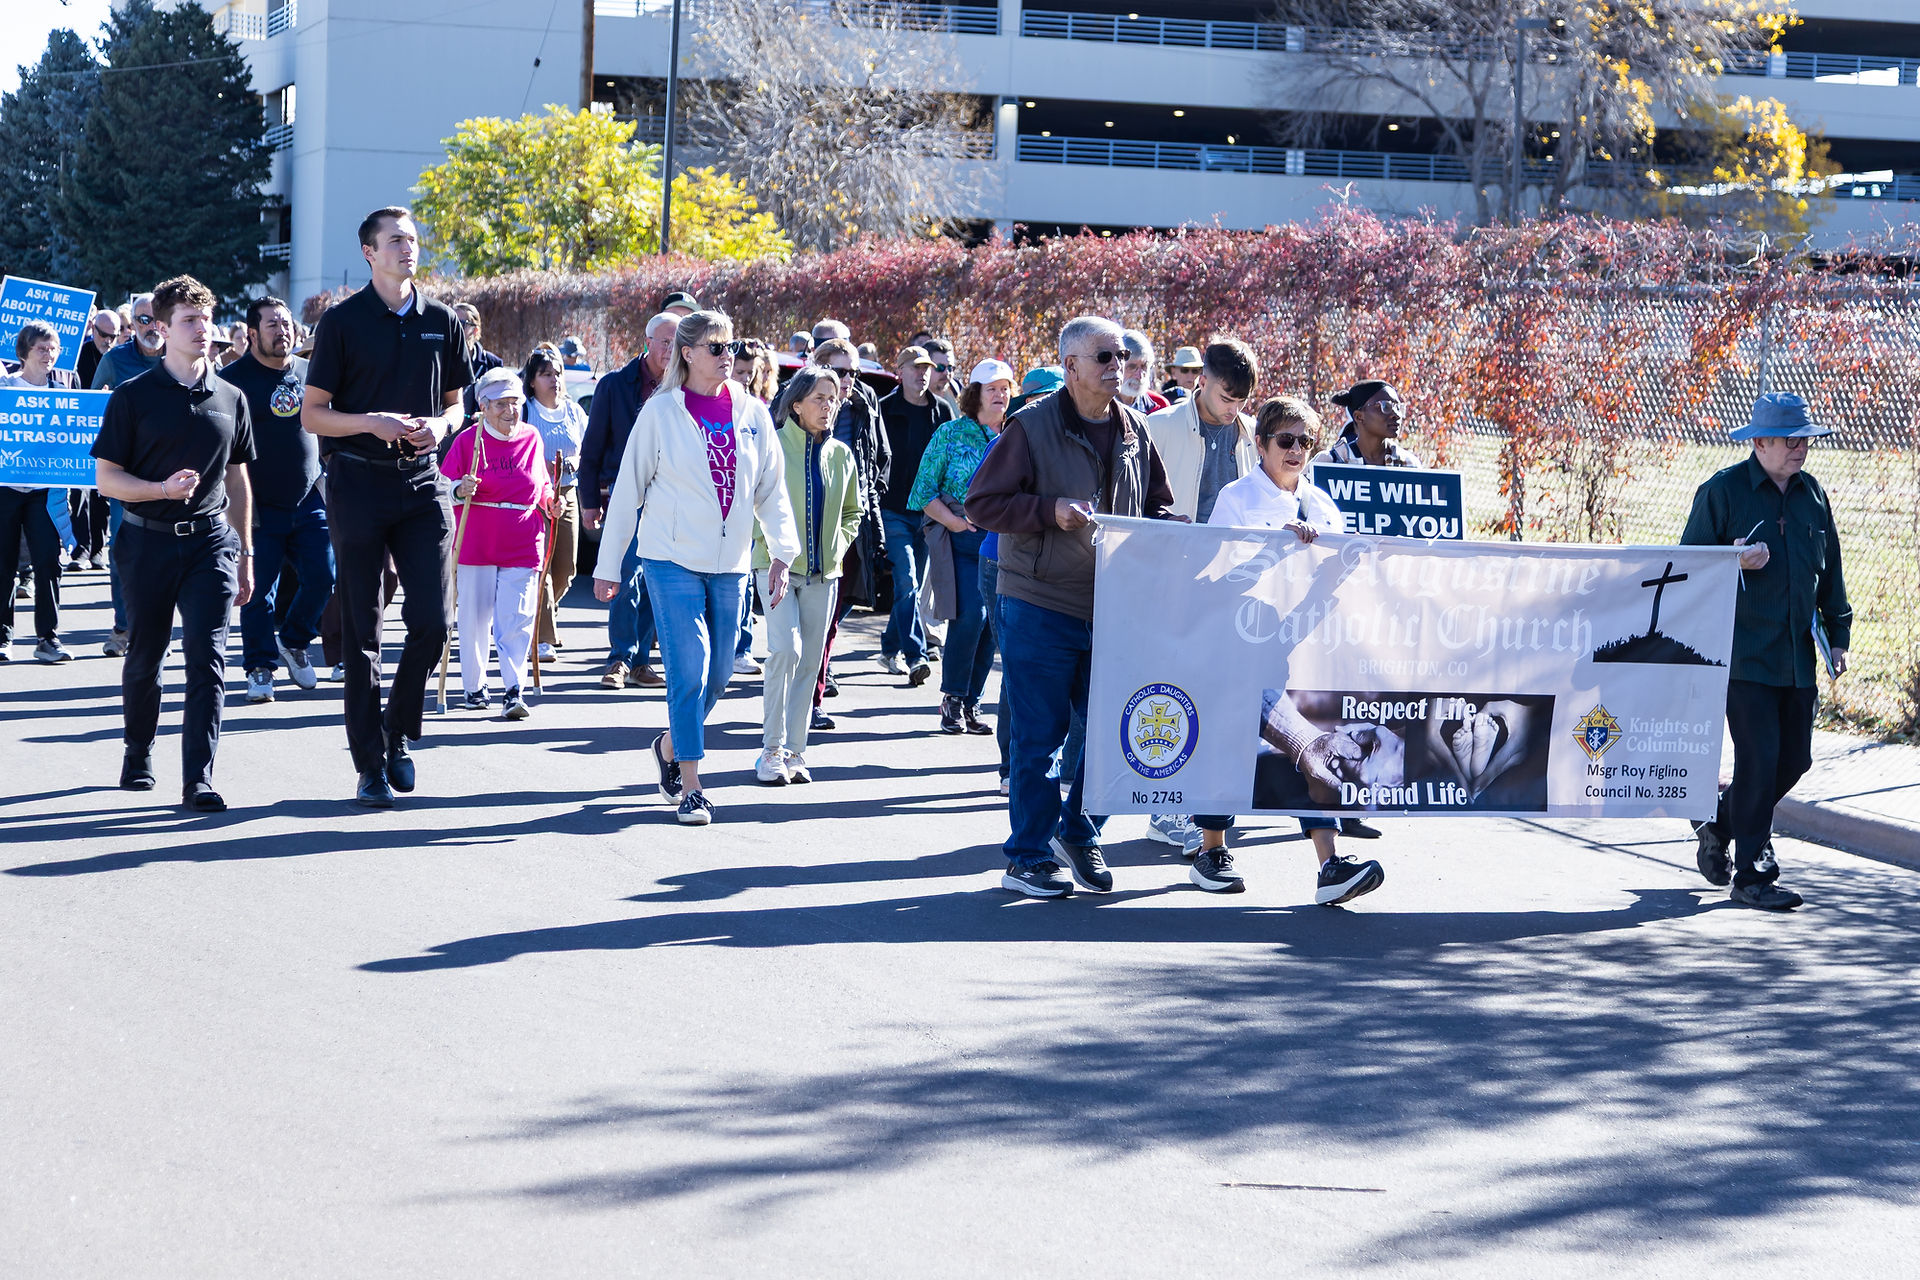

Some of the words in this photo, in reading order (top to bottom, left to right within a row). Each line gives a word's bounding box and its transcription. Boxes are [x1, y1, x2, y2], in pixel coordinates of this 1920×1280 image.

[25, 287, 50, 301] ASK
[52, 292, 71, 305] ME
[1, 298, 43, 314] ABOUT
[44, 306, 53, 317] A
[55, 308, 87, 323] FREE
[1, 313, 79, 336] ULTROUND
[15, 396, 50, 409] ASK
[55, 397, 80, 410] ME
[0, 412, 45, 425] BOUT
[49, 414, 61, 426] A
[15, 456, 46, 468] DAYS
[48, 457, 76, 469] FOR
[75, 458, 97, 470] LIF
[707, 448, 736, 468] AY
[710, 469, 735, 488] OR
[1327, 478, 1371, 502] WE
[1379, 482, 1448, 507] WILL
[1343, 511, 1392, 534] ELP
[1400, 515, 1459, 539] YOU
[1336, 537, 1601, 598] Augustine
[1235, 598, 1421, 655] Catholic
[1437, 602, 1593, 662] Church
[1358, 657, 1442, 678] BRIGHTON,
[1448, 660, 1468, 676] CO
[1125, 685, 1156, 716] CATHOLIC
[1160, 685, 1195, 717] DAUGHTERS
[1342, 695, 1428, 725] Respect
[1435, 697, 1477, 721] Life
[1629, 717, 1689, 737] Knights
[1693, 720, 1712, 735] of
[1126, 752, 1137, 764] OF
[1137, 763, 1150, 776] THE
[1153, 752, 1188, 777] AMERICAS
[1587, 764, 1618, 779] Msgr
[1621, 764, 1646, 779] Roy
[1649, 764, 1688, 780] Figlino
[1132, 791, 1148, 804] No
[1152, 791, 1183, 804] 2743
[1341, 782, 1419, 805] Defend
[1426, 782, 1468, 805] Life
[1585, 785, 1631, 798] Council
[1635, 786, 1654, 798] No.
[1657, 786, 1687, 799] 3285
